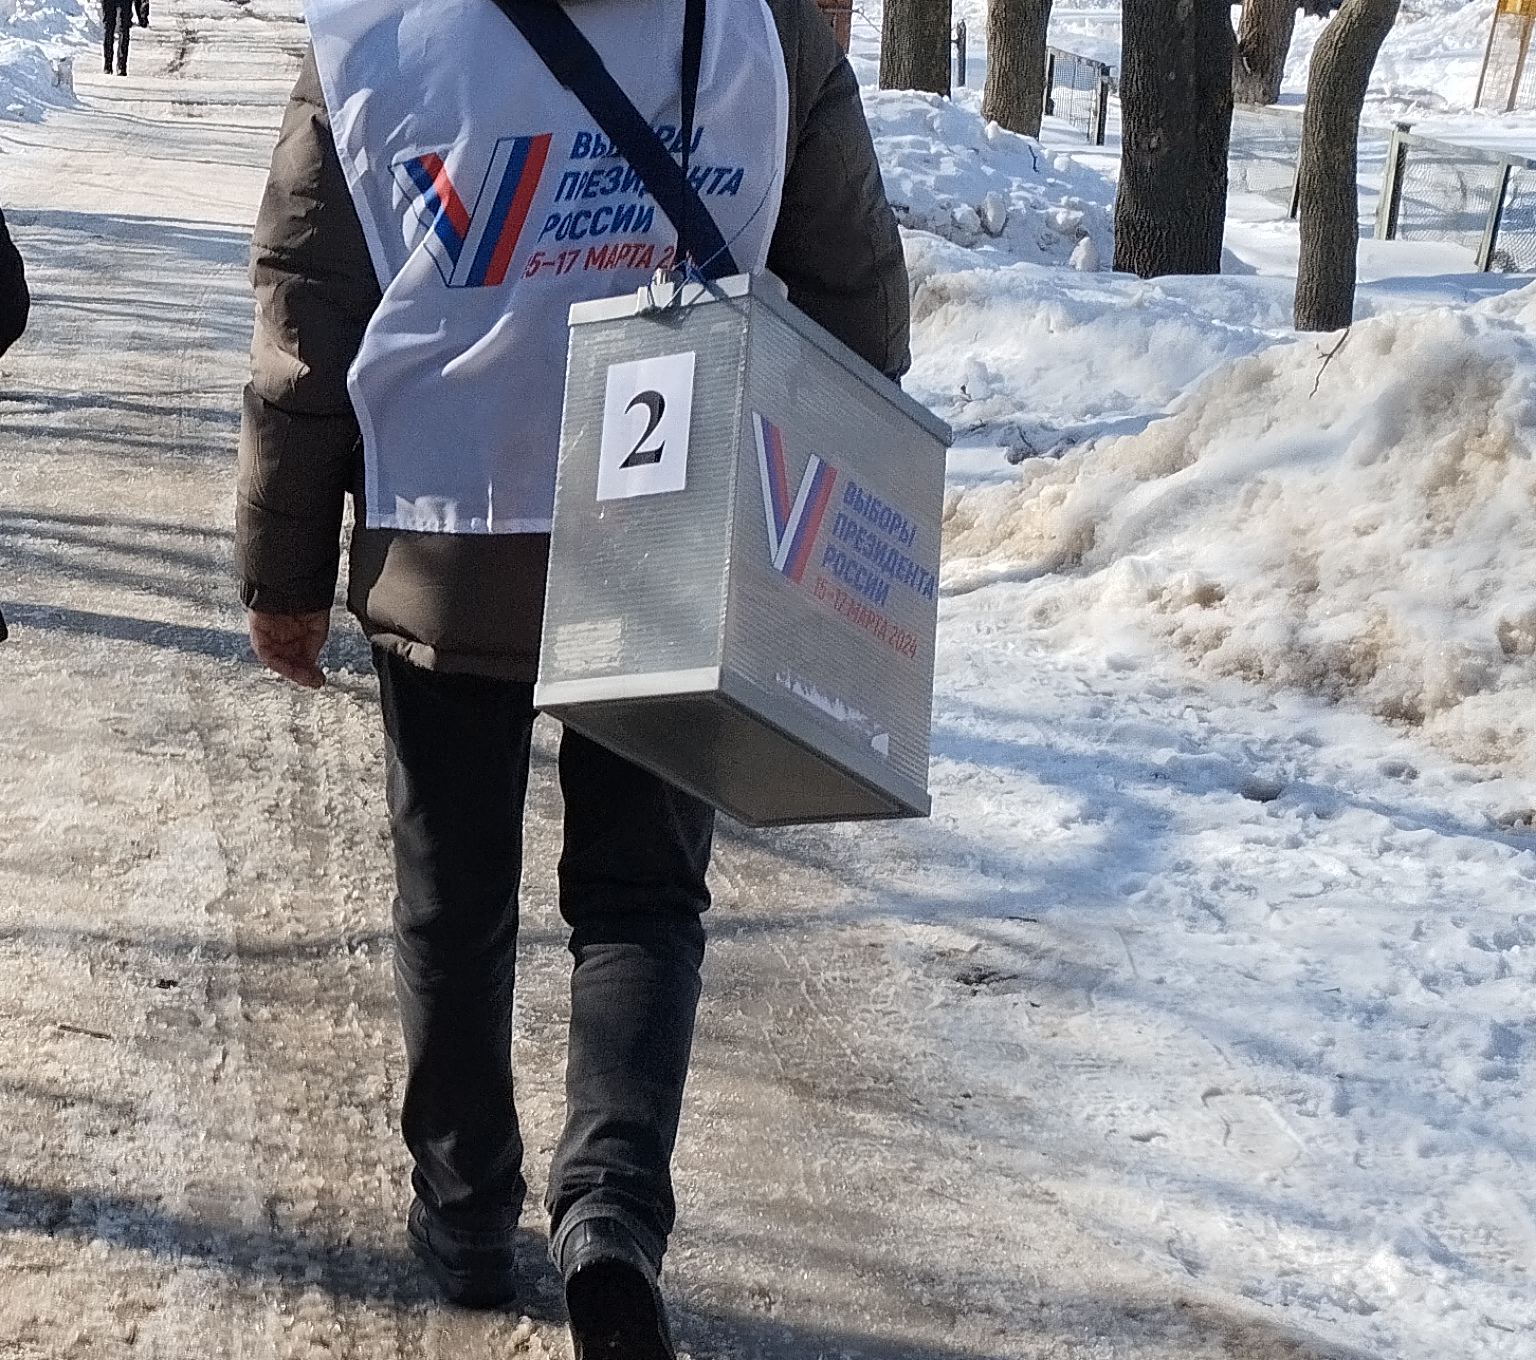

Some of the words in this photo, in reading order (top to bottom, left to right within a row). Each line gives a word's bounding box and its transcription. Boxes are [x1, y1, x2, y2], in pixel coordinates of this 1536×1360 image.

[570, 126, 704, 159] ВЫРЫ
[537, 204, 655, 243] РОССИИ
[584, 244, 655, 271] МАРТА
[619, 390, 666, 470] 2
[843, 481, 917, 547] ВЫБОРЫ
[821, 543, 890, 607] РОССИИ
[832, 511, 935, 600] ПРЕЗИДЕНТА
[888, 625, 917, 659] 2024
